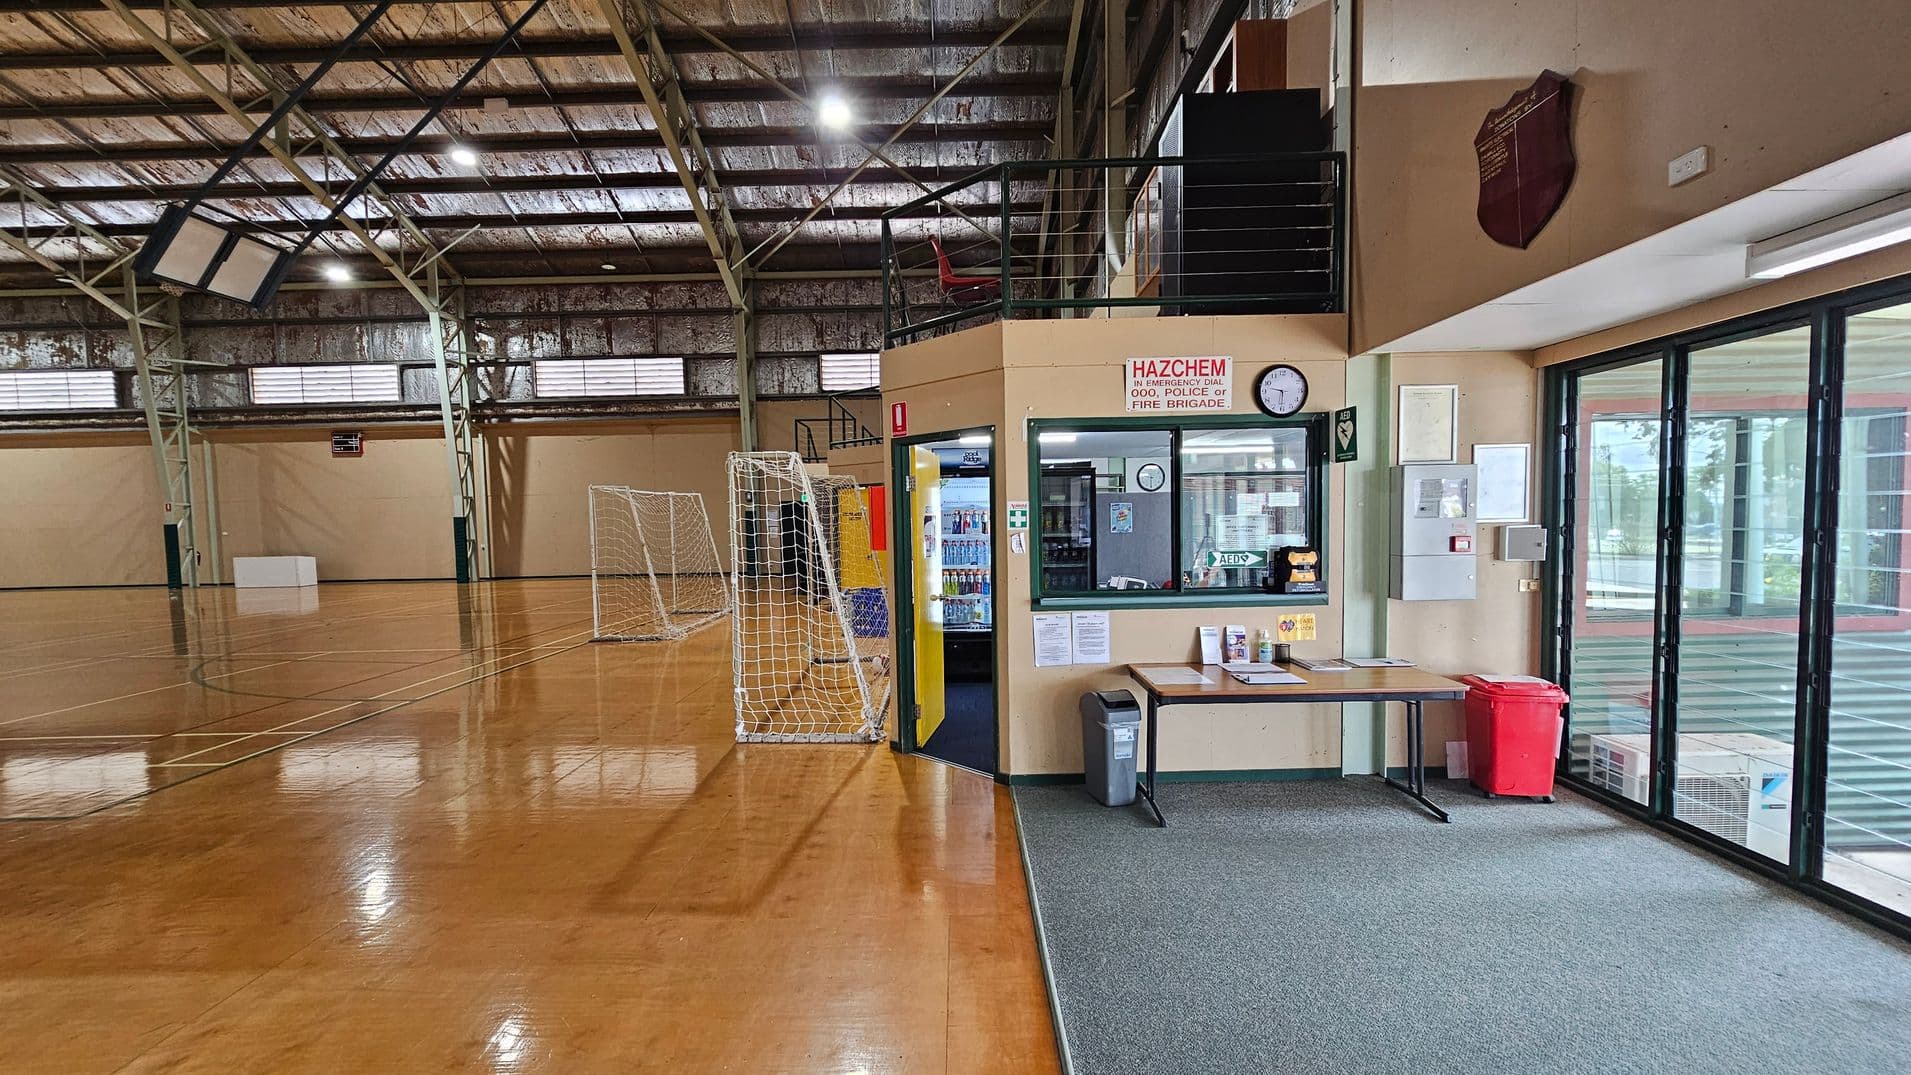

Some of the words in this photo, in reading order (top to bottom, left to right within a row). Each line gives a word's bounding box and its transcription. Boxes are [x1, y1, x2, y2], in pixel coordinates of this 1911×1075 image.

[1133, 359, 1226, 378] HAZCHEM
[1146, 379, 1201, 387] EMERGENCY
[1204, 378, 1224, 386] DIAL
[1165, 387, 1209, 397] POLICE
[1214, 388, 1227, 396] or
[1132, 400, 1161, 409] FIRE
[1167, 399, 1225, 408] BRIGADE
[1340, 410, 1351, 420] AED
[1220, 554, 1241, 564] AED
